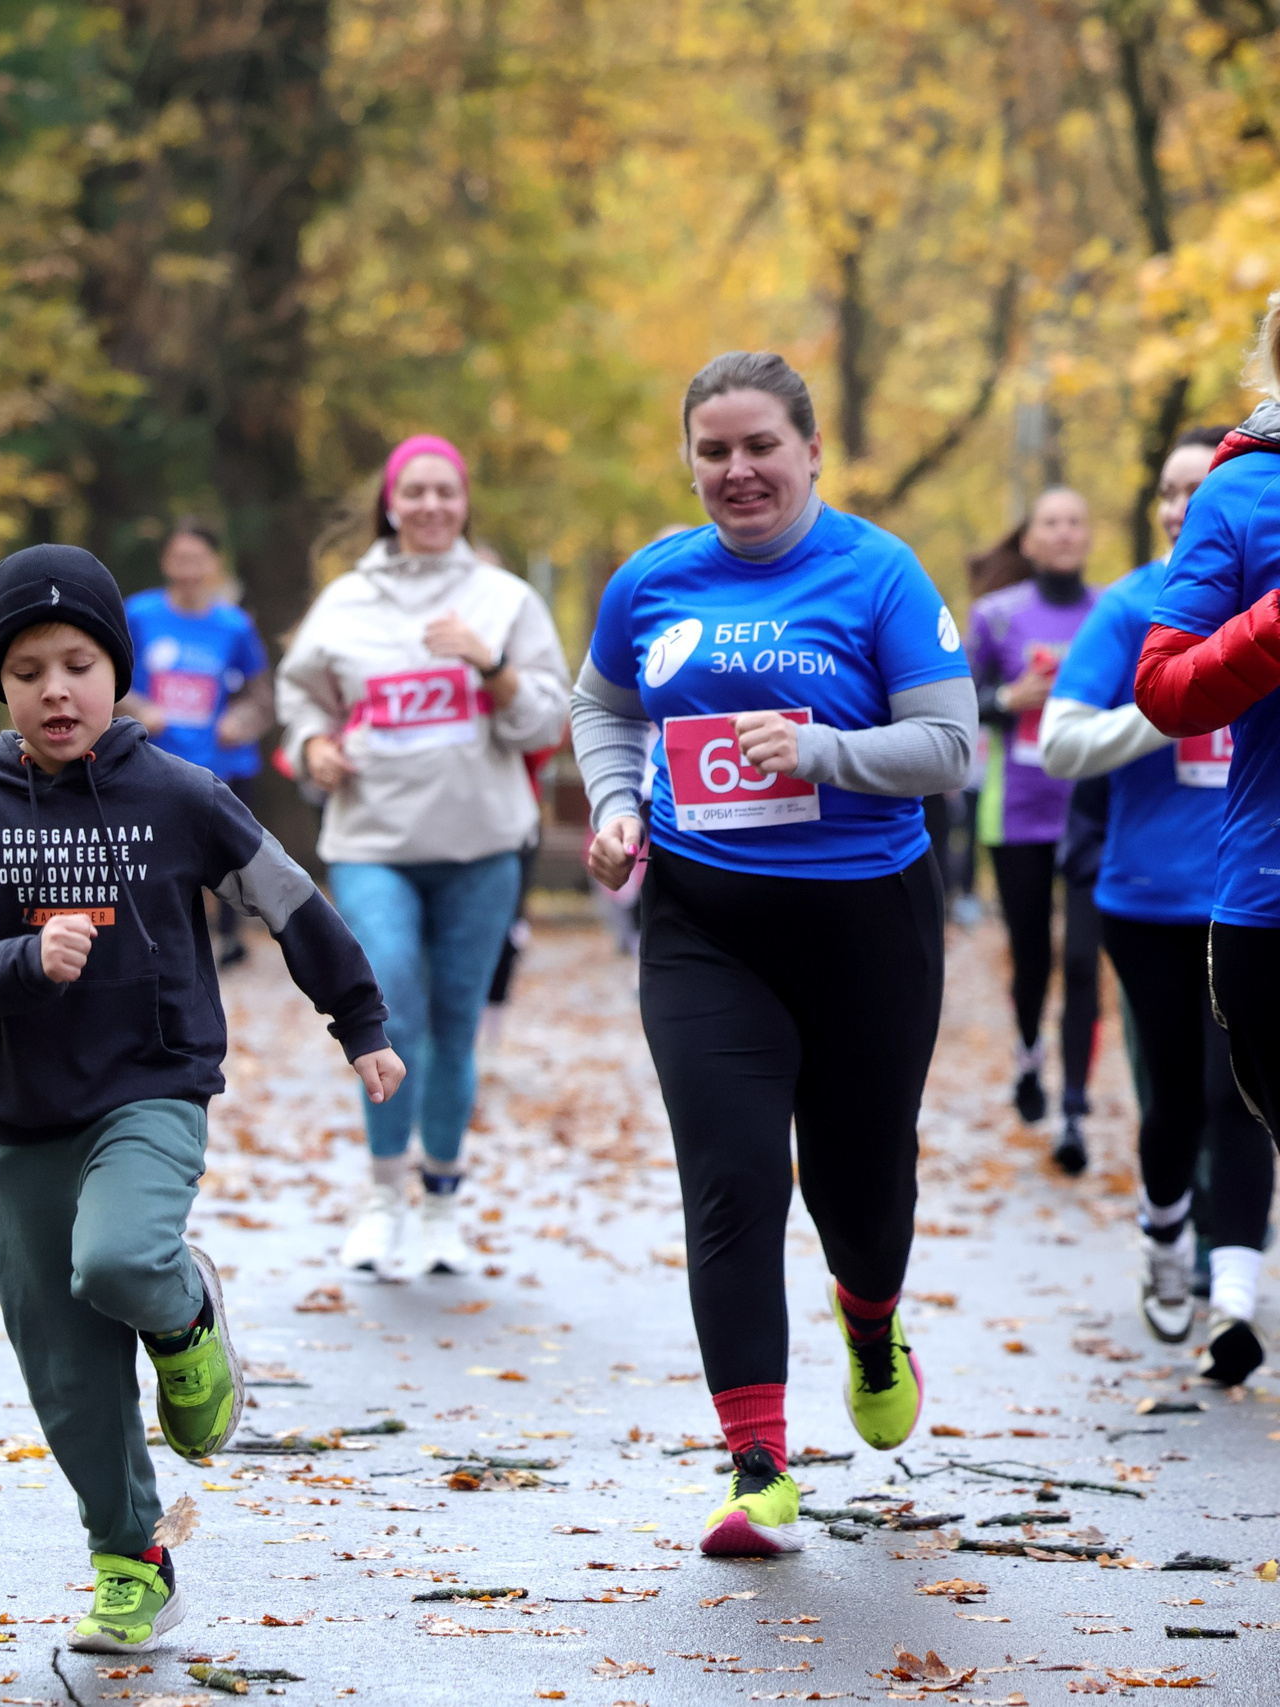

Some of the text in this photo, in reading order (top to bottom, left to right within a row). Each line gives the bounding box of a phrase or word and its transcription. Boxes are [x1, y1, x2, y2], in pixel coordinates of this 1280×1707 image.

[714, 620, 789, 644] БЕГУ
[710, 649, 837, 676] ЗА ОРБИ
[380, 677, 458, 724] 122
[703, 808, 733, 820] ОРБИ
[32, 911, 106, 923] GA ER
